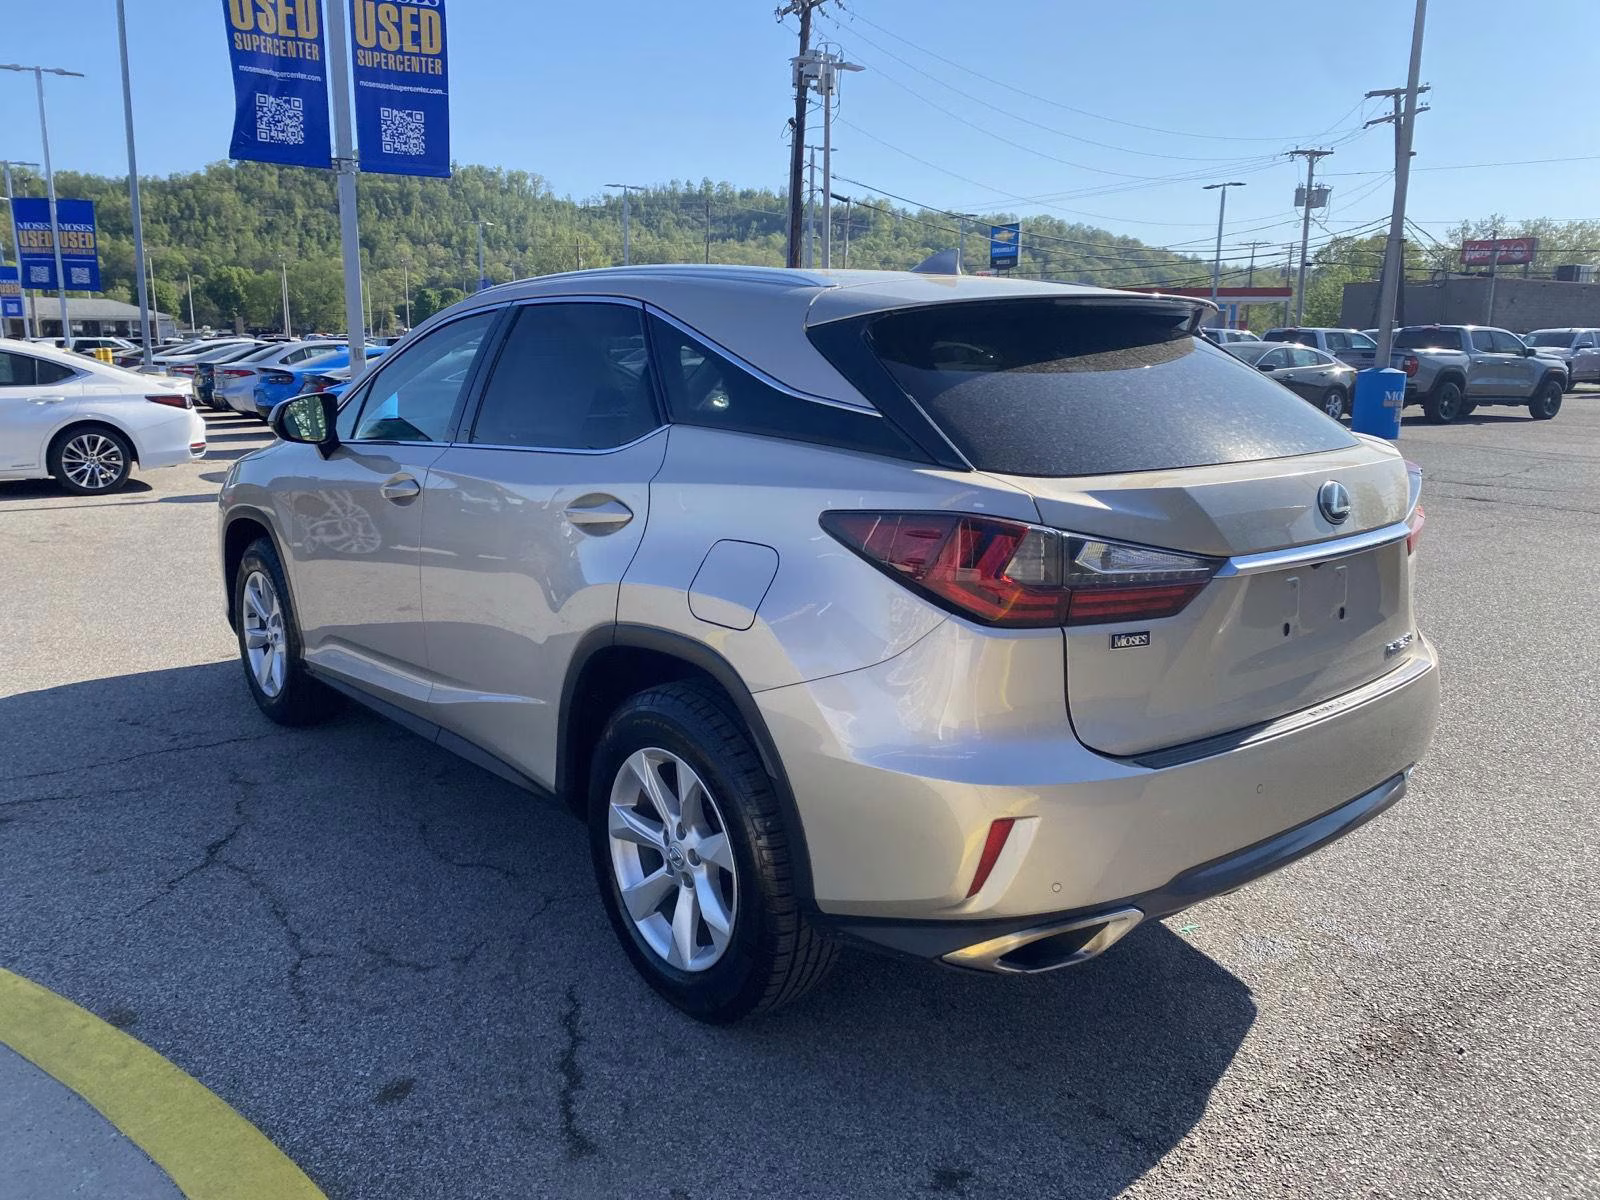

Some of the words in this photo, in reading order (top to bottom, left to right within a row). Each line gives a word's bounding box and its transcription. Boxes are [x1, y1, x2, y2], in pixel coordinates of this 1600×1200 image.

[229, 0, 319, 39] USED
[354, 0, 442, 55] USED
[234, 32, 320, 60] SUPERCENTER
[357, 49, 442, 75] SUPERCENTER
[17, 222, 52, 231] MOSES
[58, 223, 94, 232] MOSES
[18, 230, 53, 247] USED
[60, 231, 95, 249] USED
[1114, 635, 1148, 648] MOSES
